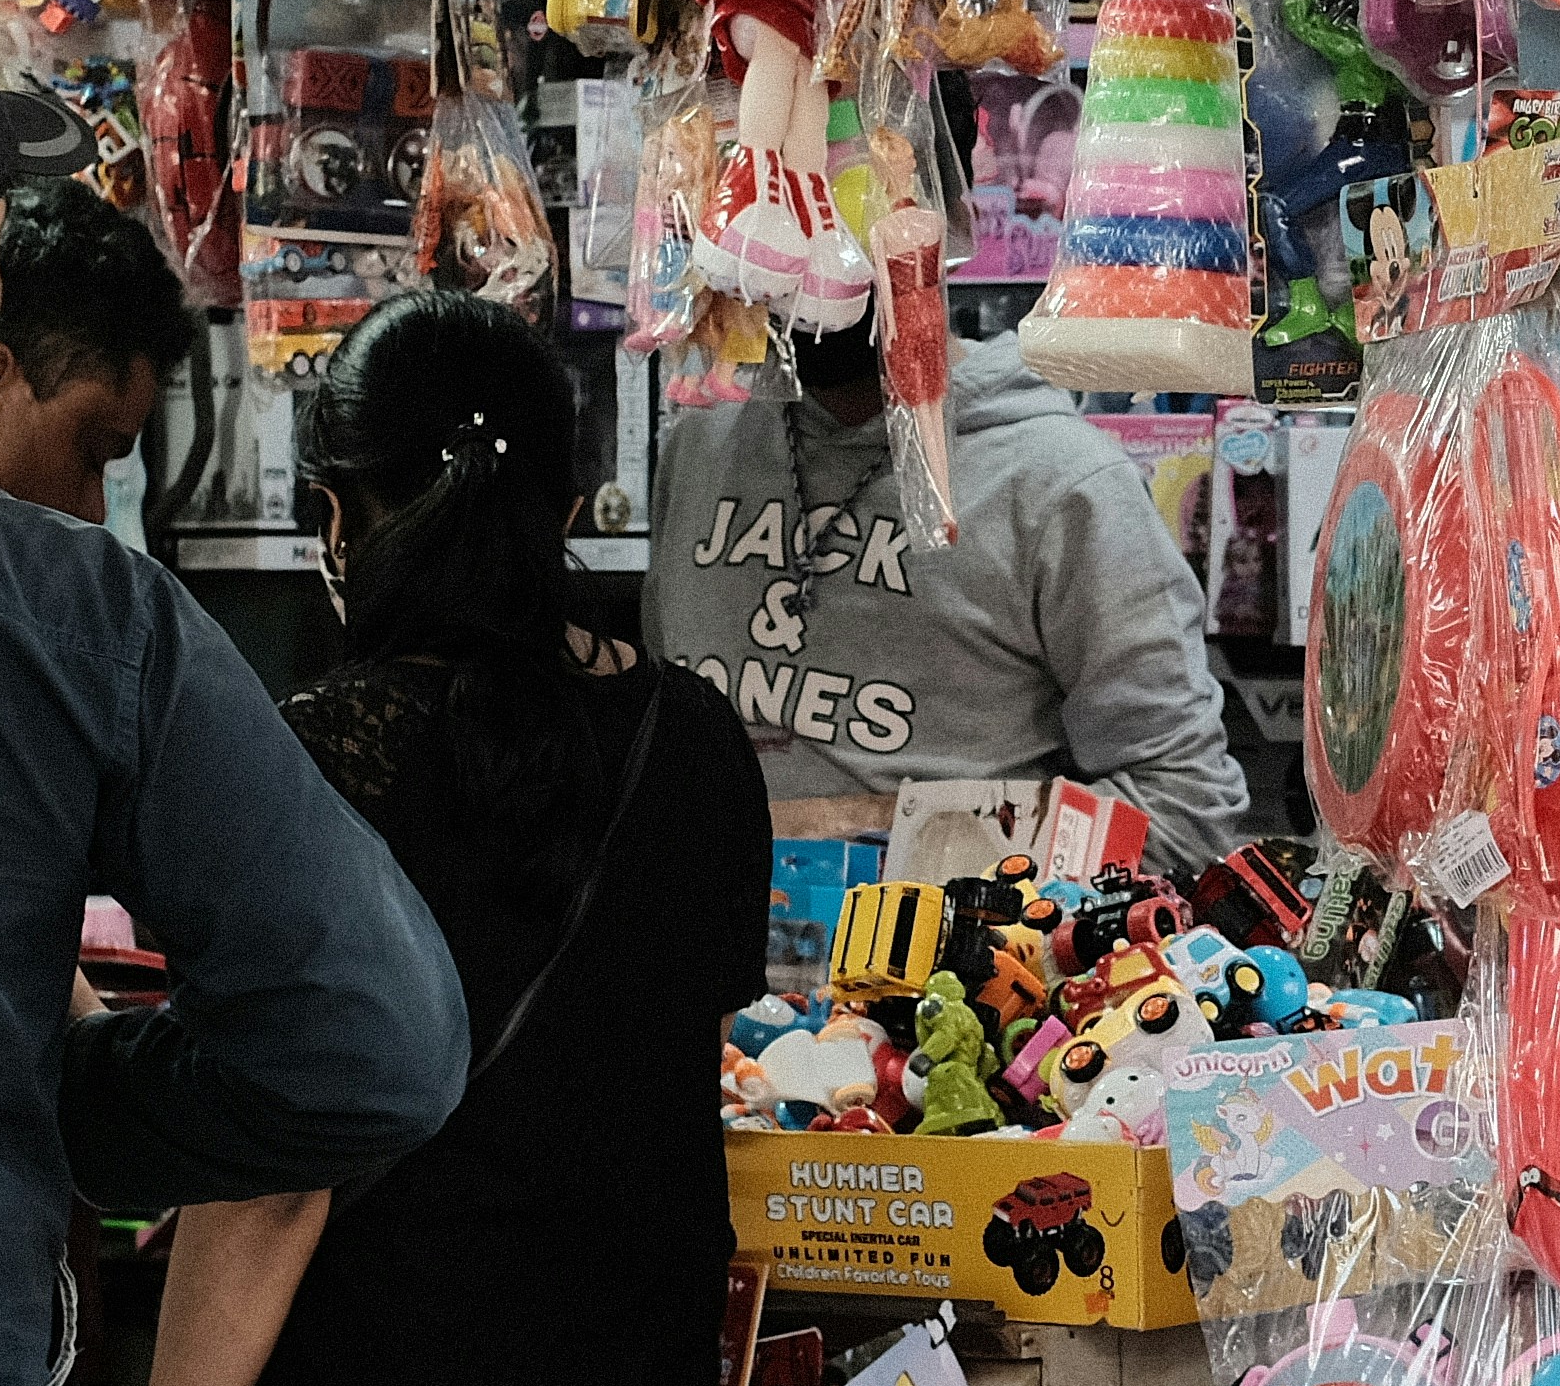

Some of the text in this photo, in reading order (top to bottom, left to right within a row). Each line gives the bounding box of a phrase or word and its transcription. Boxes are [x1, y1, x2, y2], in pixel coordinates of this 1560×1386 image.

[1512, 98, 1544, 113] ANGRY
[1288, 362, 1359, 377] FIGHTER
[694, 499, 911, 595] JACK
[748, 578, 807, 655] &
[676, 655, 915, 752] ONES
[1288, 1034, 1462, 1112] wat
[790, 1162, 924, 1192] HUMMER
[766, 1194, 954, 1228] STUNT CAR
[801, 1230, 847, 1243] SPECIAL
[897, 1235, 921, 1247] CAR
[772, 1247, 952, 1268] UNLIMITED FUN
[777, 1264, 951, 1289] Children Favorite Toys
